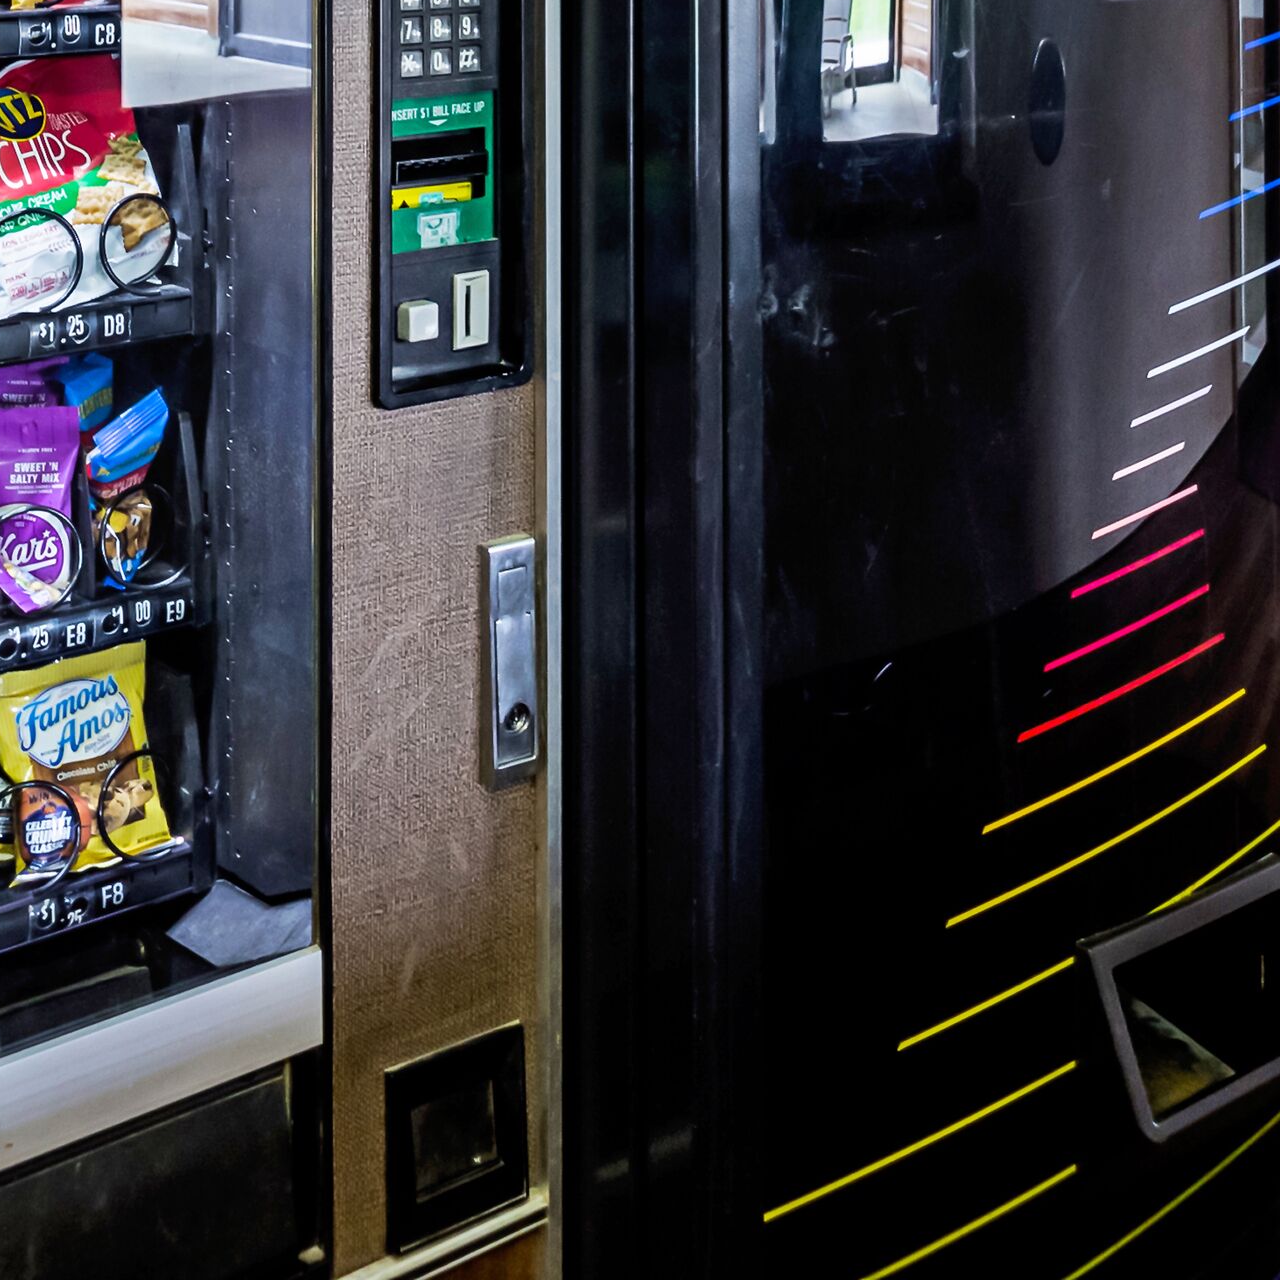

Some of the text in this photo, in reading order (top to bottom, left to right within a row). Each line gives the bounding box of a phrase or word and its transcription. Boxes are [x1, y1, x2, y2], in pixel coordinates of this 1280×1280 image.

[95, 23, 115, 46] C8
[404, 22, 413, 40] 7
[462, 18, 470, 36] 9
[420, 101, 486, 119] $1 BILL FACE UP
[46, 111, 89, 131] TOASTED
[27, 187, 68, 208] CREAM
[103, 314, 125, 337] D8
[14, 462, 45, 472] SWEET
[9, 473, 60, 484] SALTY MIX
[166, 599, 185, 623] E9
[66, 630, 86, 649] E8
[16, 673, 120, 752] Famous
[50, 701, 131, 767] Amos
[56, 766, 96, 782] Chocolate
[28, 792, 50, 805] WIN
[29, 841, 65, 856] CLASSIC
[101, 882, 124, 909] F8
